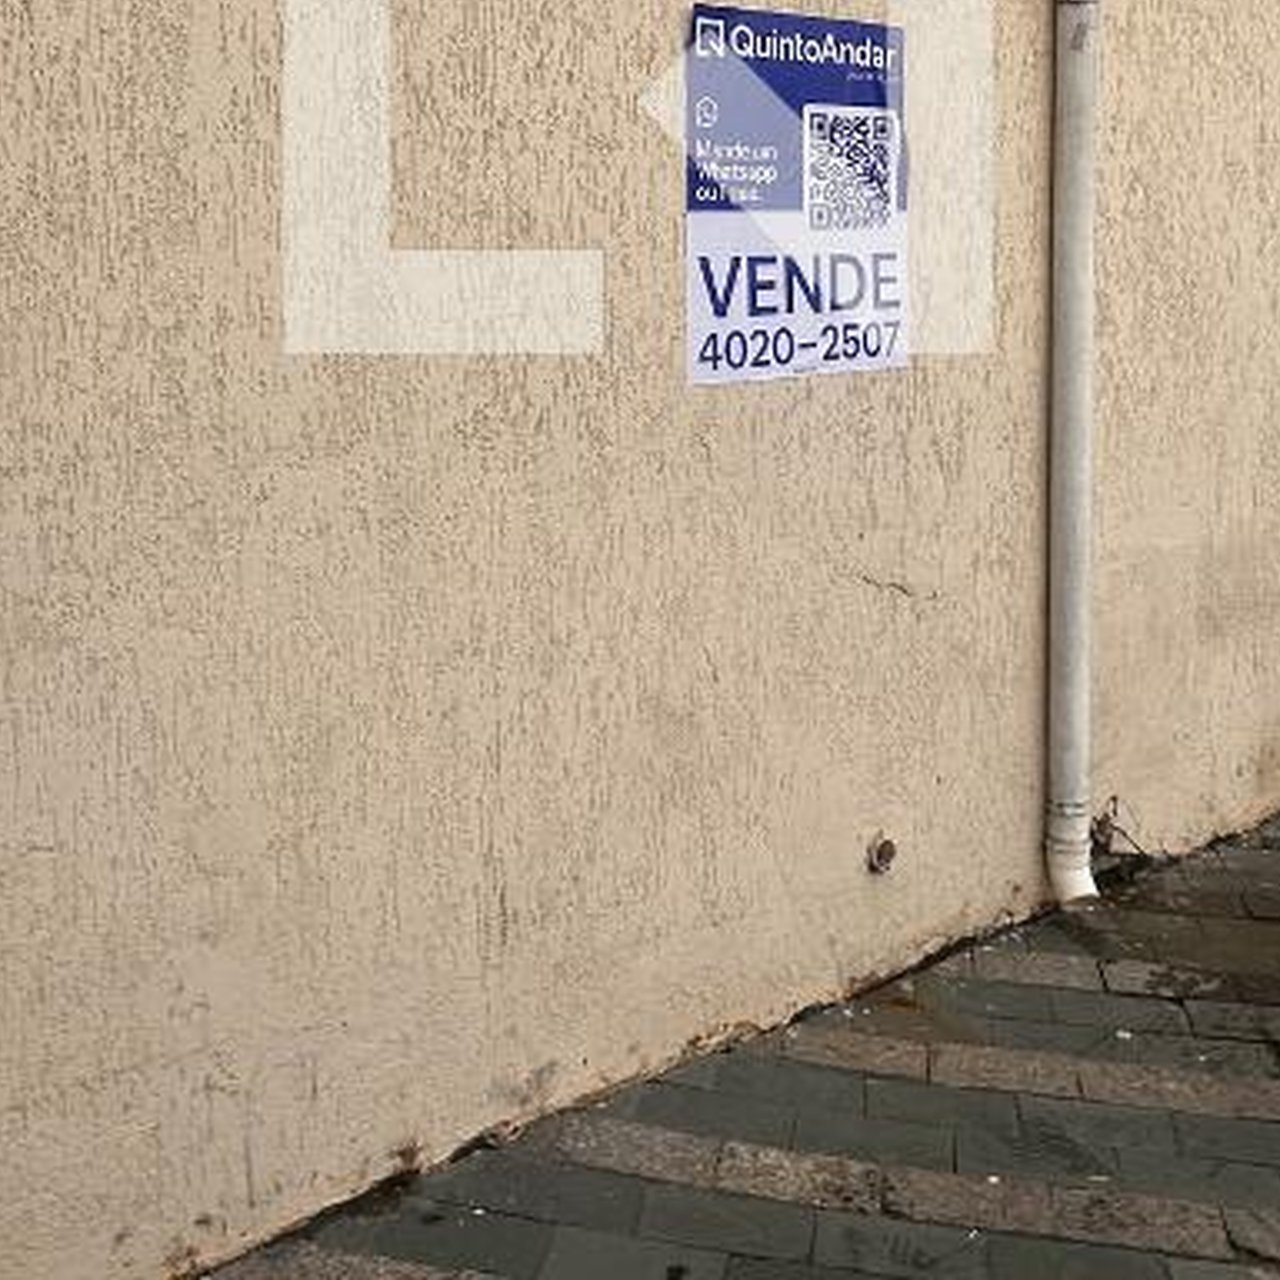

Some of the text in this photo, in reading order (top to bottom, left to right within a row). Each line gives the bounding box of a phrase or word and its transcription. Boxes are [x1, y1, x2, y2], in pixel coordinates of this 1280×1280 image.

[730, 24, 896, 69] QuintoAndar
[697, 253, 901, 318] VENDE
[698, 320, 901, 371] 4020-2507
